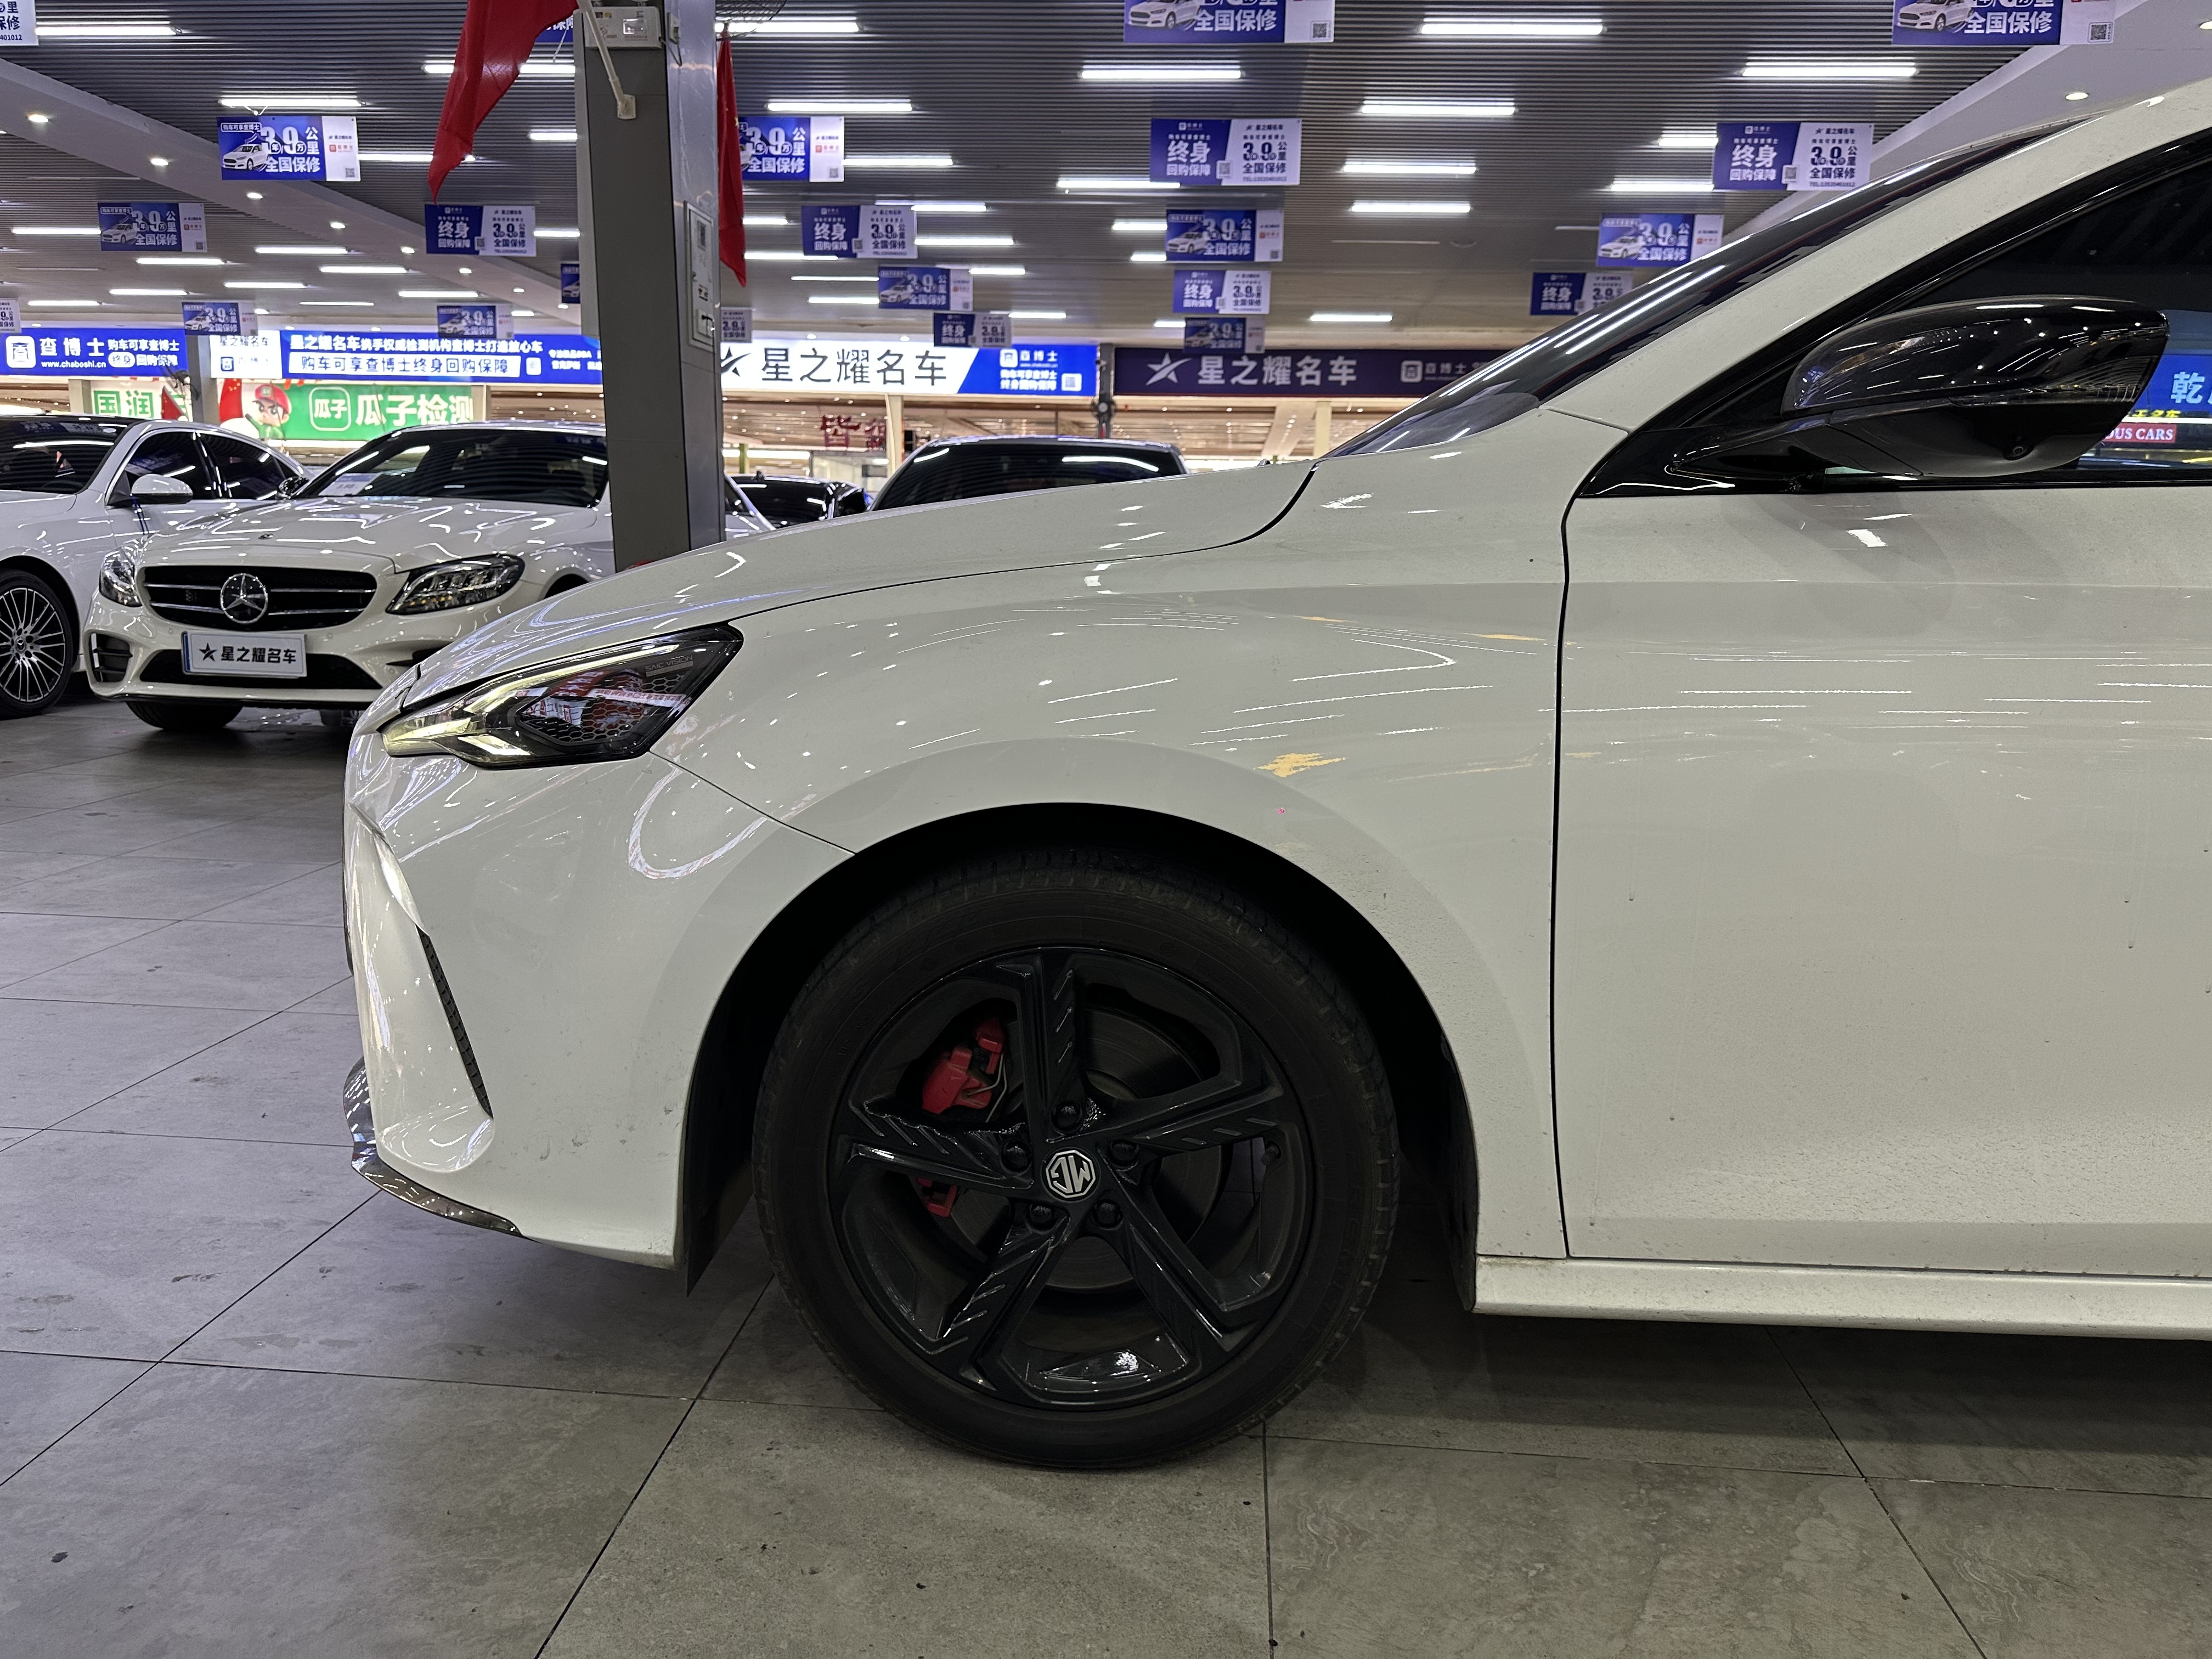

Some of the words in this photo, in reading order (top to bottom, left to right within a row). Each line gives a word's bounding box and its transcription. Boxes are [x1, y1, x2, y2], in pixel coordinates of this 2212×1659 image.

[1193, 9, 1277, 32] 全国保修
[1963, 10, 2053, 34] 全国保修
[1167, 140, 1211, 163] 终身
[1731, 144, 1778, 168] 终身
[266, 156, 320, 173] 全国保修
[747, 157, 805, 173] 全国保修
[1242, 162, 1286, 174] 全国保修
[1809, 167, 1856, 179] 全国保修
[1729, 168, 1777, 181] 回购保障
[438, 221, 470, 238] 终身
[814, 222, 847, 240] 终身
[136, 234, 177, 246] 全国保修
[40, 337, 104, 357] 查博士
[108, 339, 180, 352] 购车可享查博士
[41, 360, 106, 368] www.chaboshi.cn
[302, 356, 508, 374] 购车可享查博士终身回购保障
[761, 347, 947, 386] 星之耀名车
[1198, 355, 1358, 386] 星之耀名车
[2170, 371, 2212, 405] 乾
[314, 398, 347, 419] 瓜子
[356, 394, 473, 426] 瓜子检测
[2135, 428, 2174, 441] CARS
[221, 645, 297, 664] 星之耀名车
[645, 662, 664, 672] SAIC
[665, 654, 693, 666] VISION
[1050, 1154, 1091, 1194] MG
